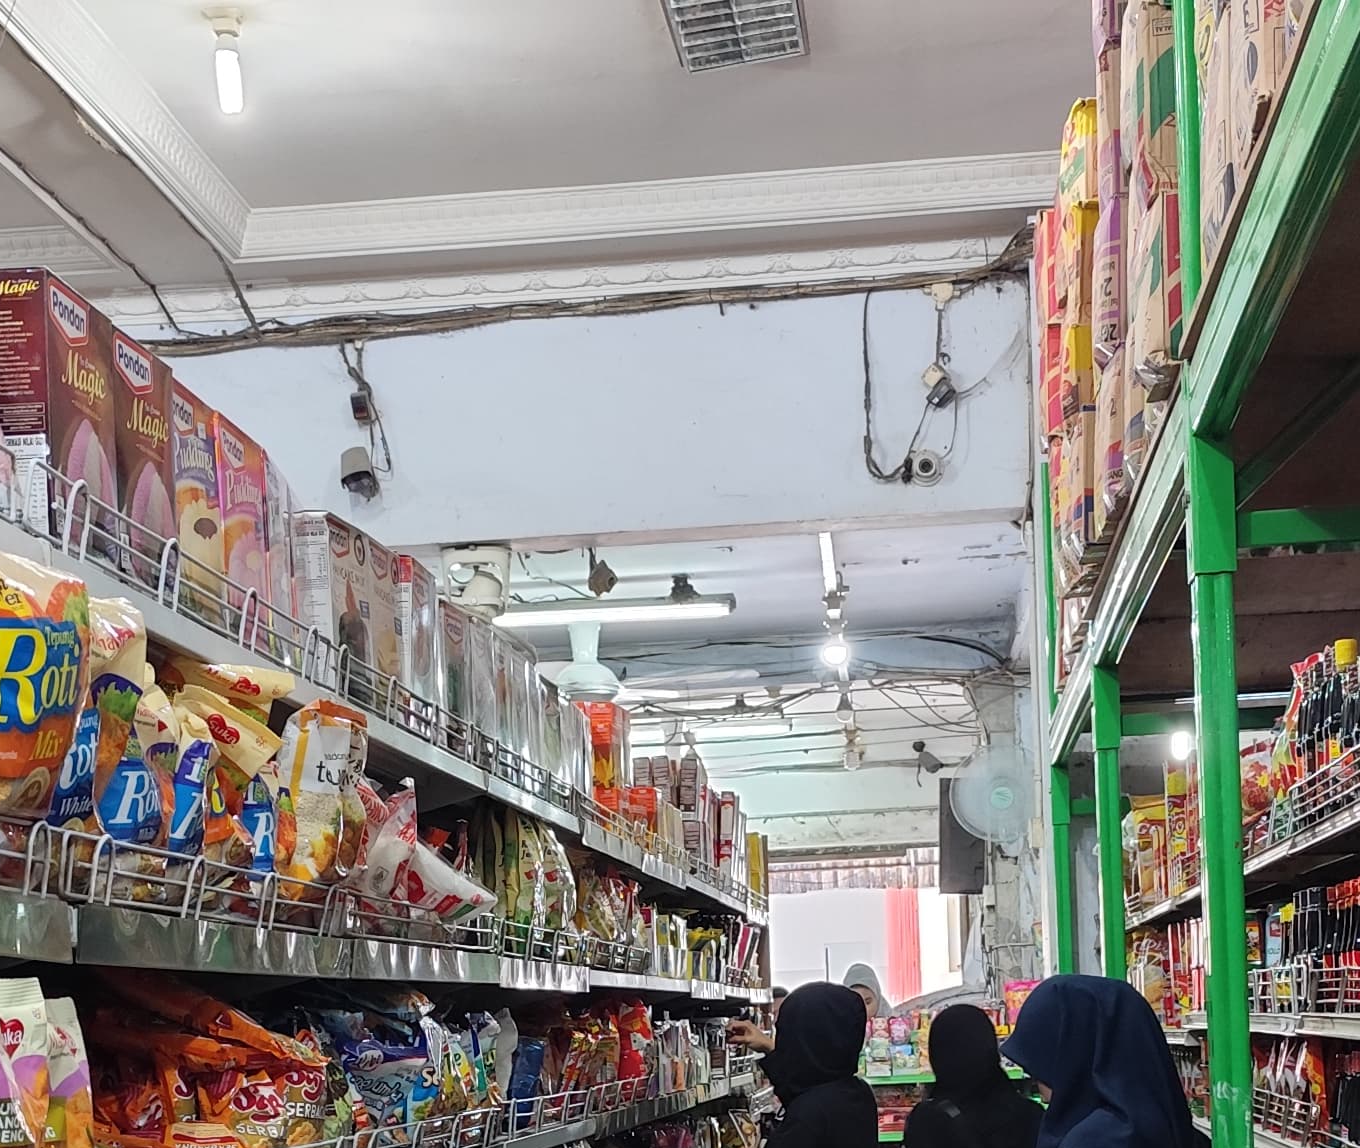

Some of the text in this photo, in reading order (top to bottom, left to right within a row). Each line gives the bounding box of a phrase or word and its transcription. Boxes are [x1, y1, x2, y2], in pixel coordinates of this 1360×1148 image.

[51, 291, 86, 335] Pondan
[61, 349, 108, 404] Magic
[116, 343, 153, 384] Pondan
[126, 396, 170, 449] Magic
[1, 1027, 24, 1047] uka
